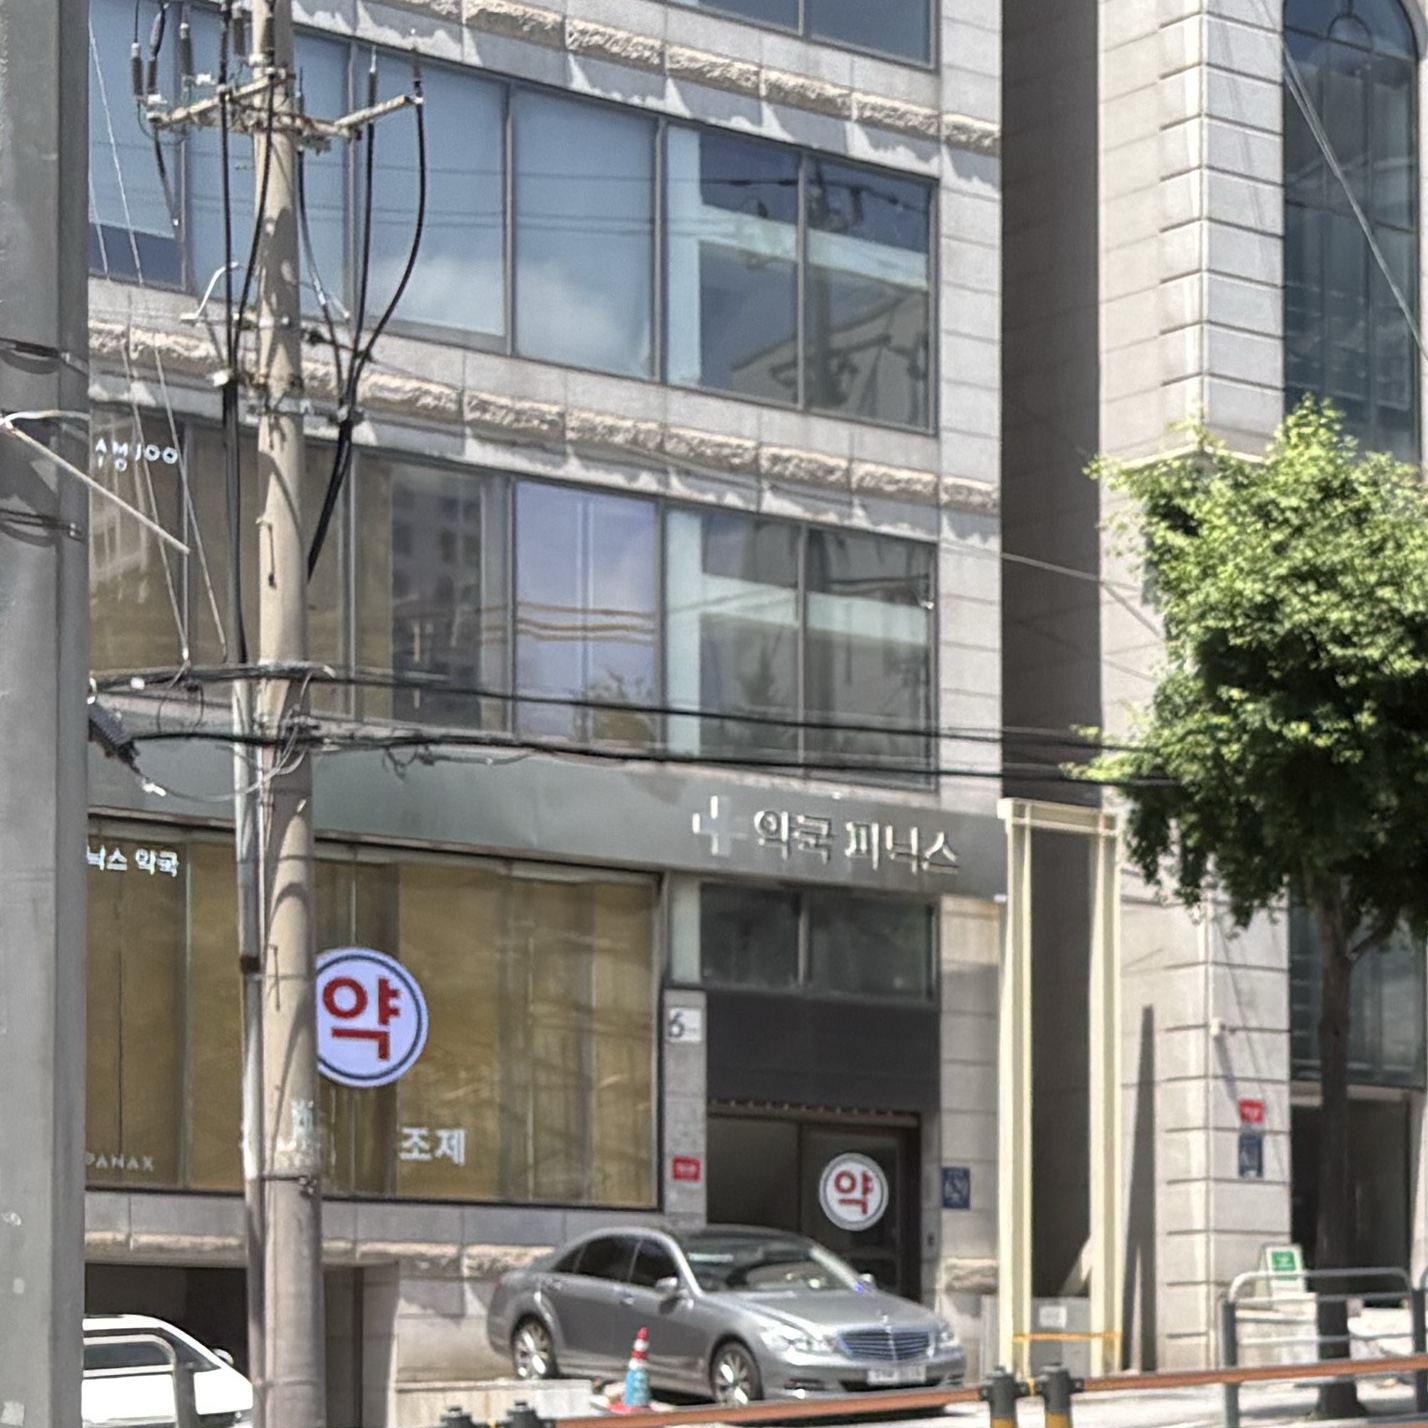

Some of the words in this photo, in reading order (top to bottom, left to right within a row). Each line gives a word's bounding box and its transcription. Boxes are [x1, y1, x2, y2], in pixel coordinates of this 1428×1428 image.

[753, 810, 832, 864] 약국
[135, 848, 180, 877] 약국
[322, 975, 401, 1061] 약
[668, 1010, 686, 1038] 6
[399, 1126, 466, 1168] 조제
[834, 1170, 874, 1215] 약
